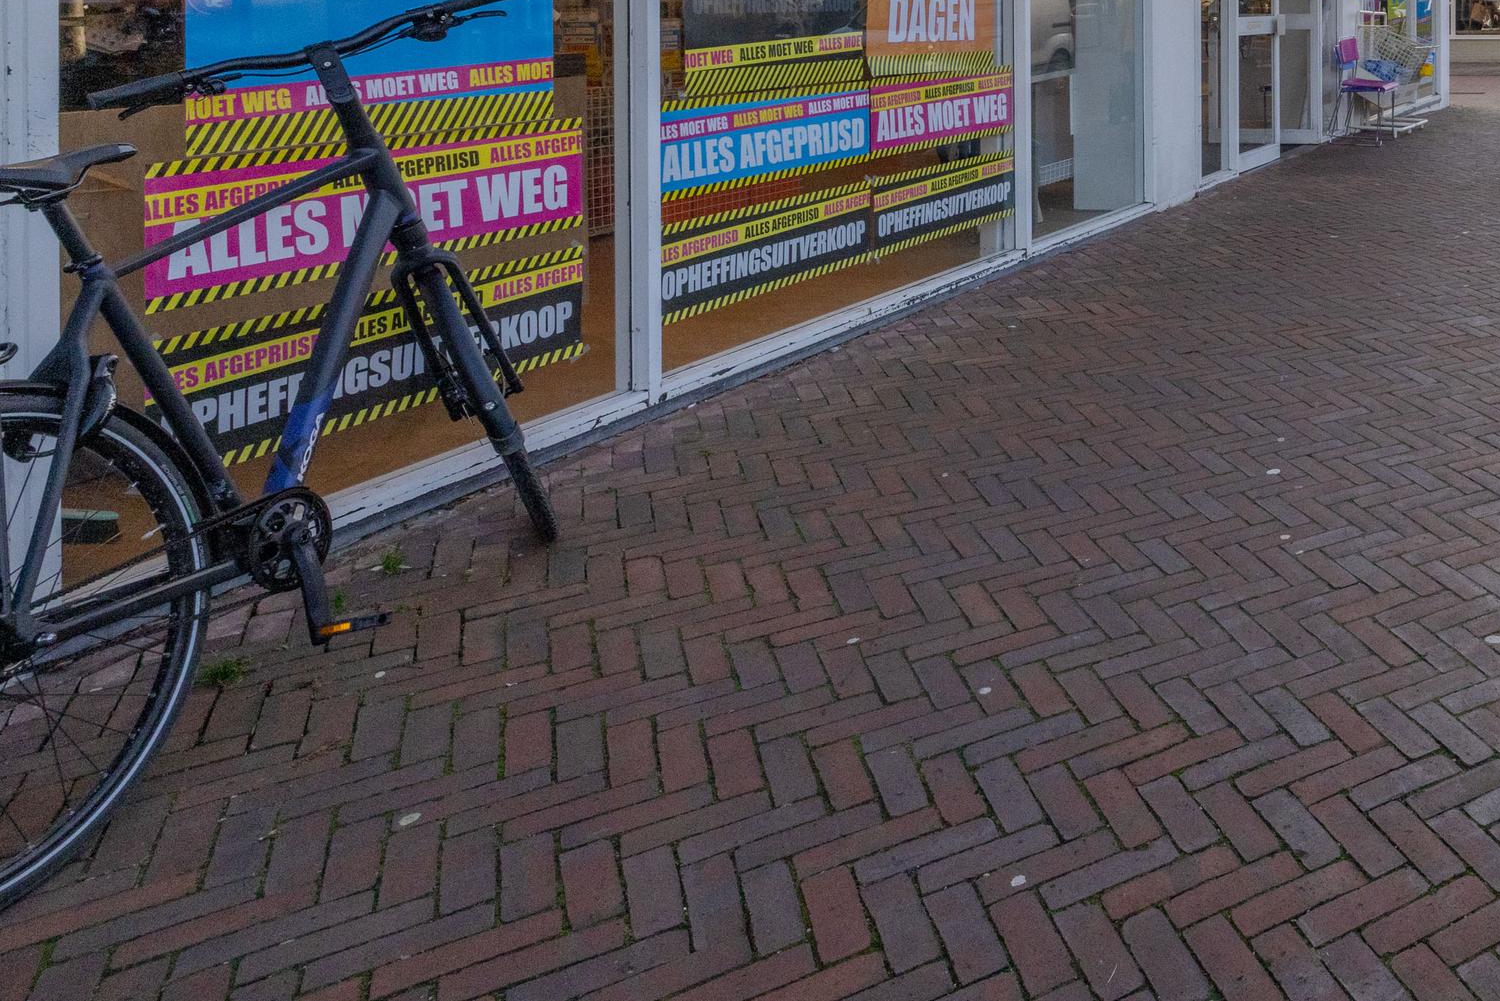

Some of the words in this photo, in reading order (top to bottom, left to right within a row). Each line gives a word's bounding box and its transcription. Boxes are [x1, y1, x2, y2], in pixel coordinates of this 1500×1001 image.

[740, 45, 767, 62] ALLES
[768, 42, 794, 58] MOET
[794, 40, 814, 55] WEG
[818, 36, 841, 52] ALLES
[710, 49, 733, 65] WEG
[469, 65, 514, 87] ALLES
[241, 88, 292, 112] WEG
[306, 79, 362, 107] ALS
[366, 75, 416, 99] MOET
[419, 70, 459, 93] WEG
[925, 86, 942, 99] ALLES
[942, 82, 975, 96] AFGEPRIJSD
[733, 112, 759, 128] ALLES
[759, 108, 783, 124] MOET
[783, 104, 804, 120] WEG
[808, 99, 832, 116] ALLES
[832, 96, 855, 112] MOET
[877, 104, 926, 142] ALLES
[927, 98, 971, 133] MOET
[972, 93, 1007, 124] WEG
[679, 119, 706, 138] MOET
[706, 115, 729, 133] WEG
[490, 142, 532, 164] ALLES
[662, 135, 735, 184] ALLES
[739, 117, 865, 170] AFGEPRIJSD
[396, 150, 480, 178] FGEPRIJSD
[931, 177, 948, 191] ALLES
[948, 168, 979, 187] AFGEPRIJSD
[823, 200, 844, 217] ALLES
[878, 181, 1011, 238] OPHEFFINGSUITVERKOOP
[167, 200, 330, 281] ALLES
[341, 179, 468, 248] MET
[475, 164, 568, 223] WEG
[744, 221, 770, 240] ALLES
[771, 207, 820, 232] AFGEPRIJSD
[661, 246, 680, 264] LES
[682, 229, 739, 258] AFGEPRIJSD
[661, 220, 866, 301] OPHEFFINGSUITVERKOOP
[493, 276, 532, 302] ALLES
[297, 412, 324, 482] KOGA
